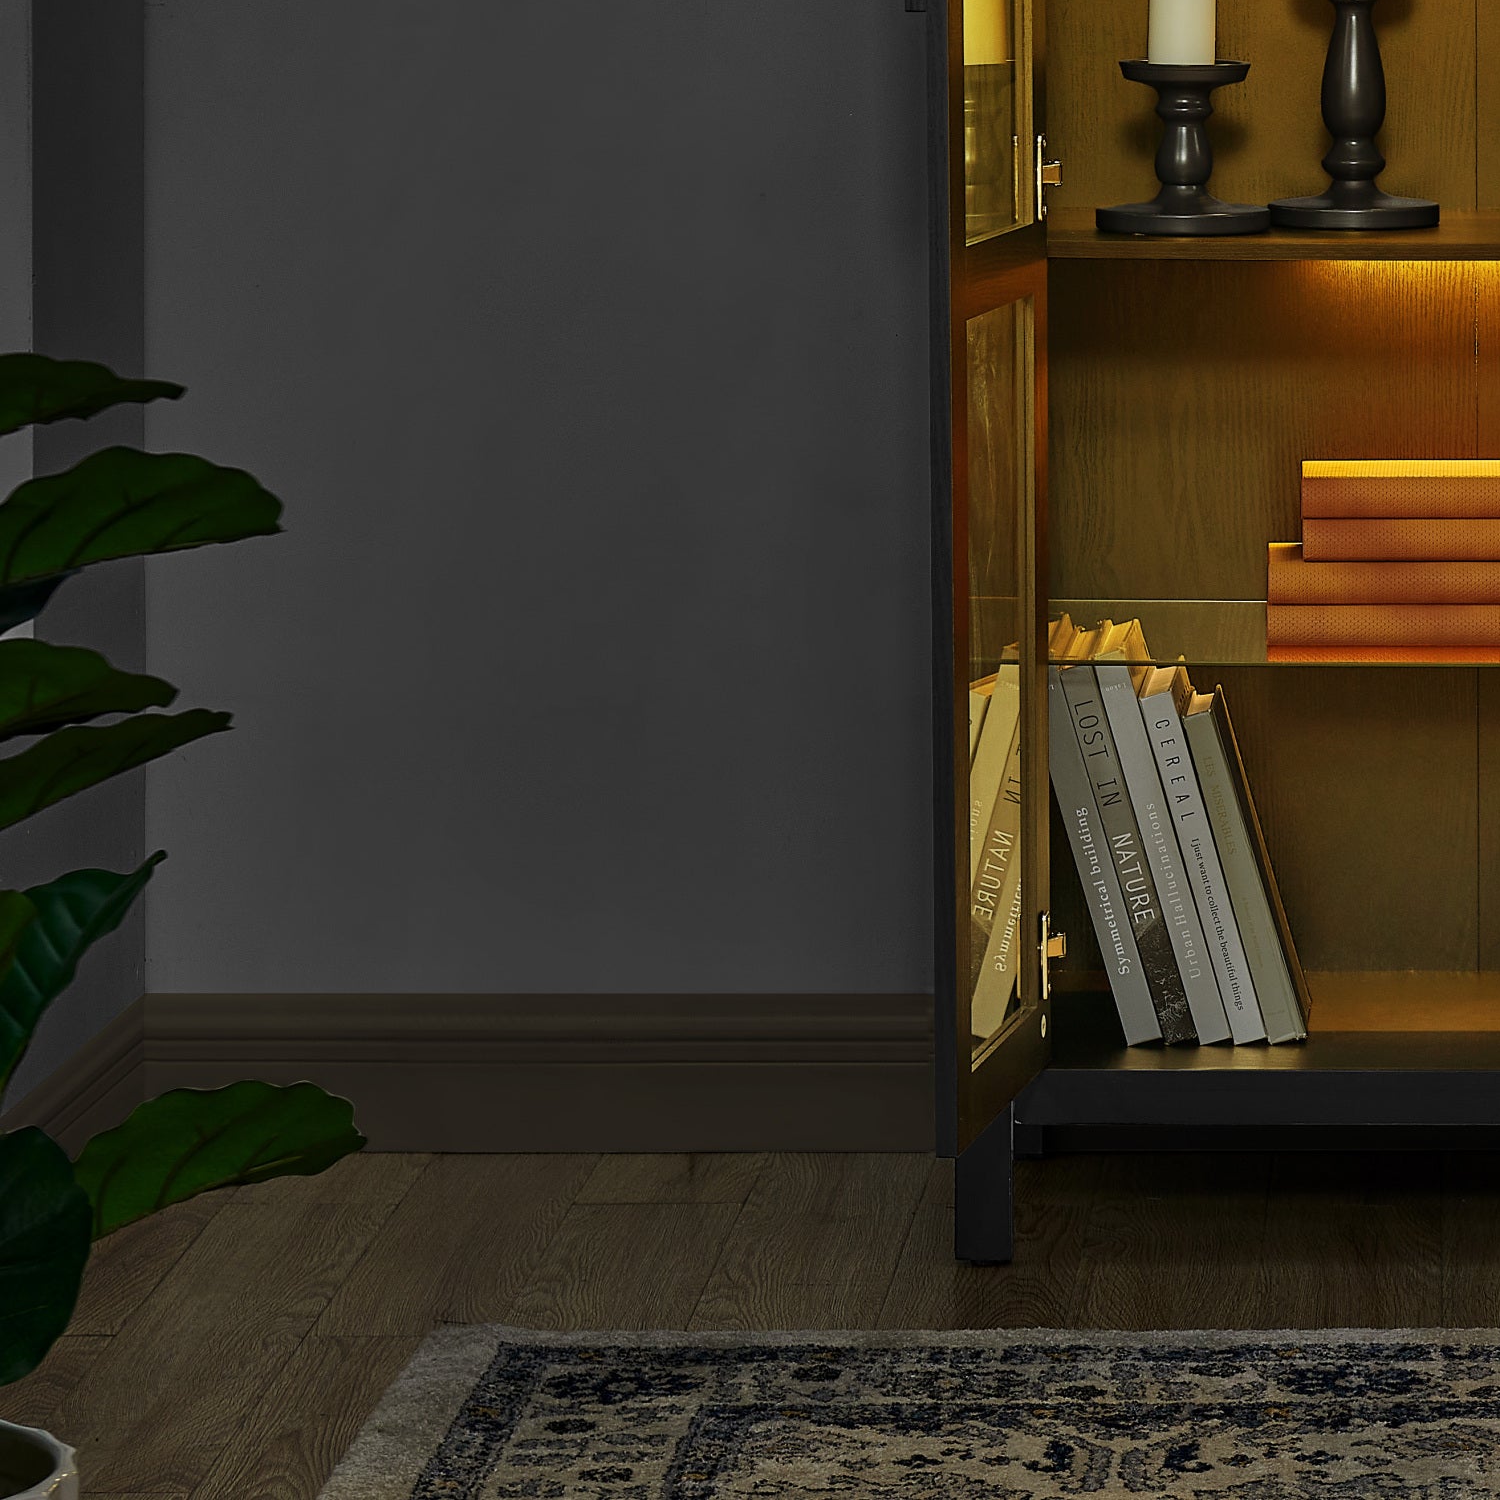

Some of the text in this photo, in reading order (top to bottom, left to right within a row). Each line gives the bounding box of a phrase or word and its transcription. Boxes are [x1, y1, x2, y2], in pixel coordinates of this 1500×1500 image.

[1155, 719, 1195, 822] CEREAL
[1074, 700, 1156, 924] LOST IN NATURE
[1203, 755, 1238, 856] LES MISERABLES
[1190, 842, 1201, 861] just
[1198, 861, 1210, 884] want
[1204, 884, 1213, 895] to
[1075, 807, 1131, 976] Symmetrical building
[1146, 803, 1201, 980] Urban Hallucinations
[1207, 895, 1221, 925] collect
[1214, 925, 1225, 941] the
[1220, 940, 1238, 980] beautiful
[1231, 980, 1244, 1011] things
